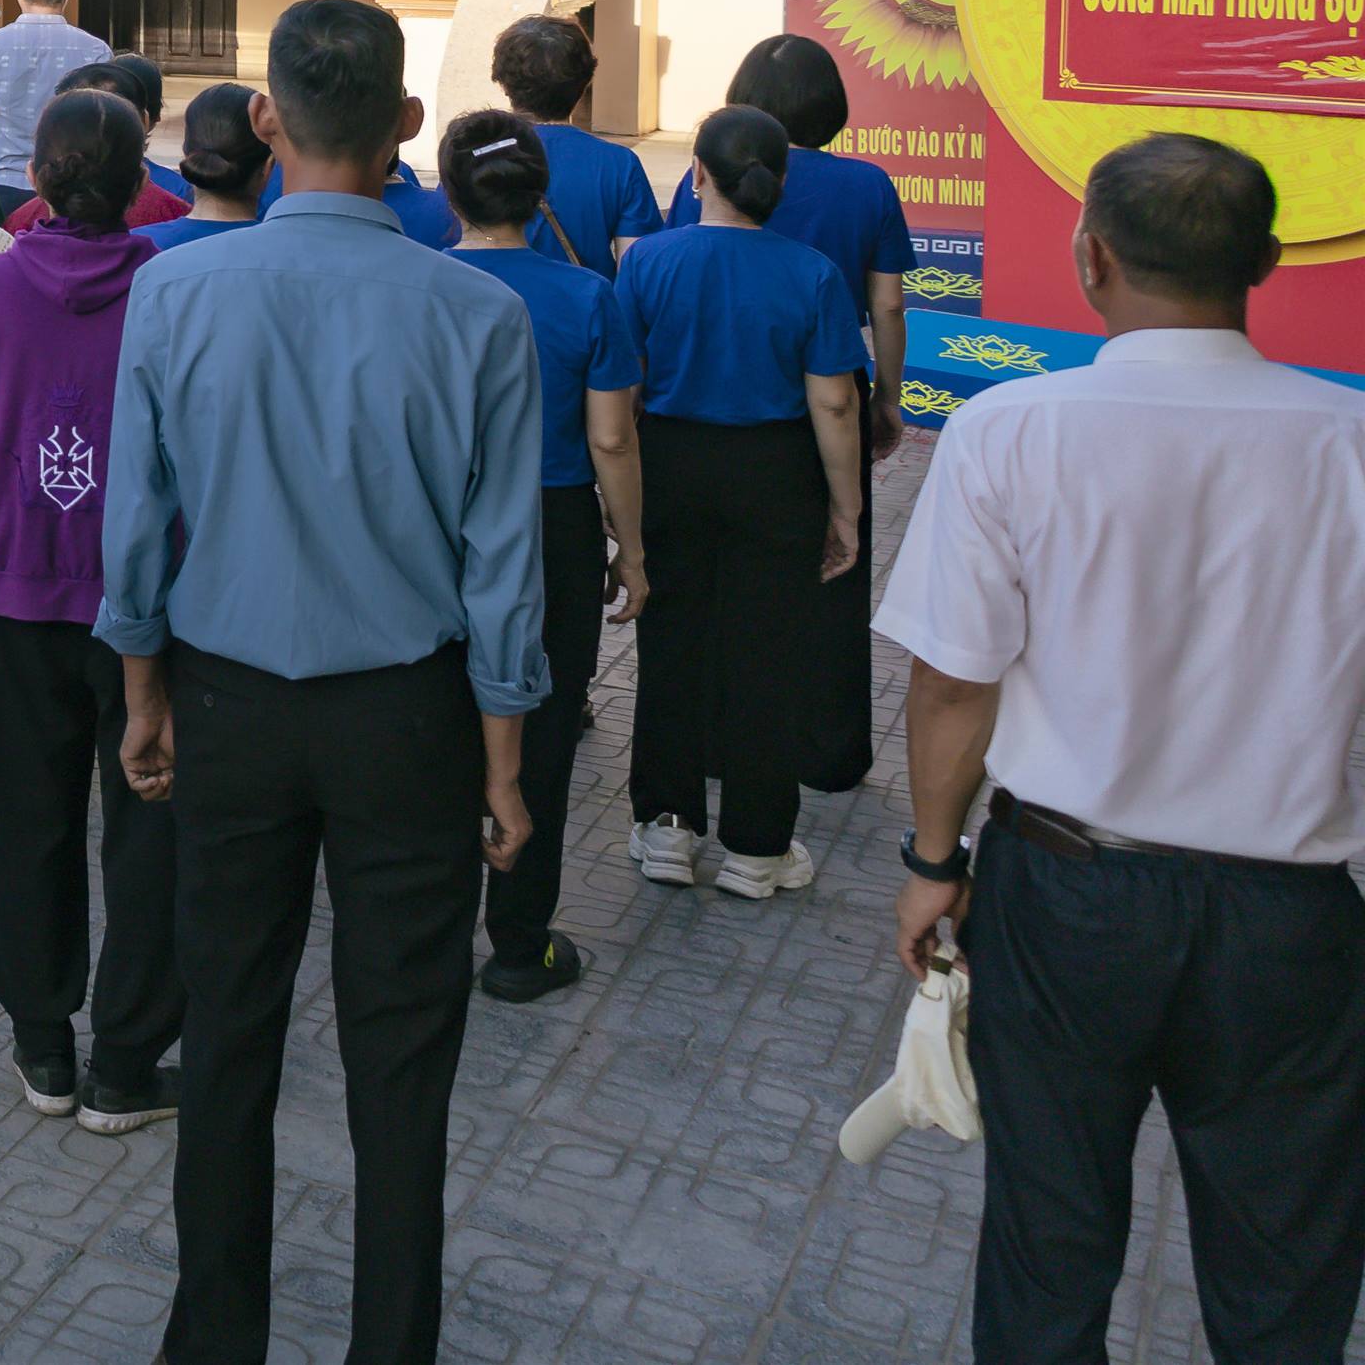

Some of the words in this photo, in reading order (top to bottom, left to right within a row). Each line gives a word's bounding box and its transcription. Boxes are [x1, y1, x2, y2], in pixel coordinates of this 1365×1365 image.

[857, 124, 902, 155] BƯỚC
[906, 125, 940, 156] VÀO
[944, 123, 966, 158] KỶ
[938, 175, 985, 206] MÌNH
